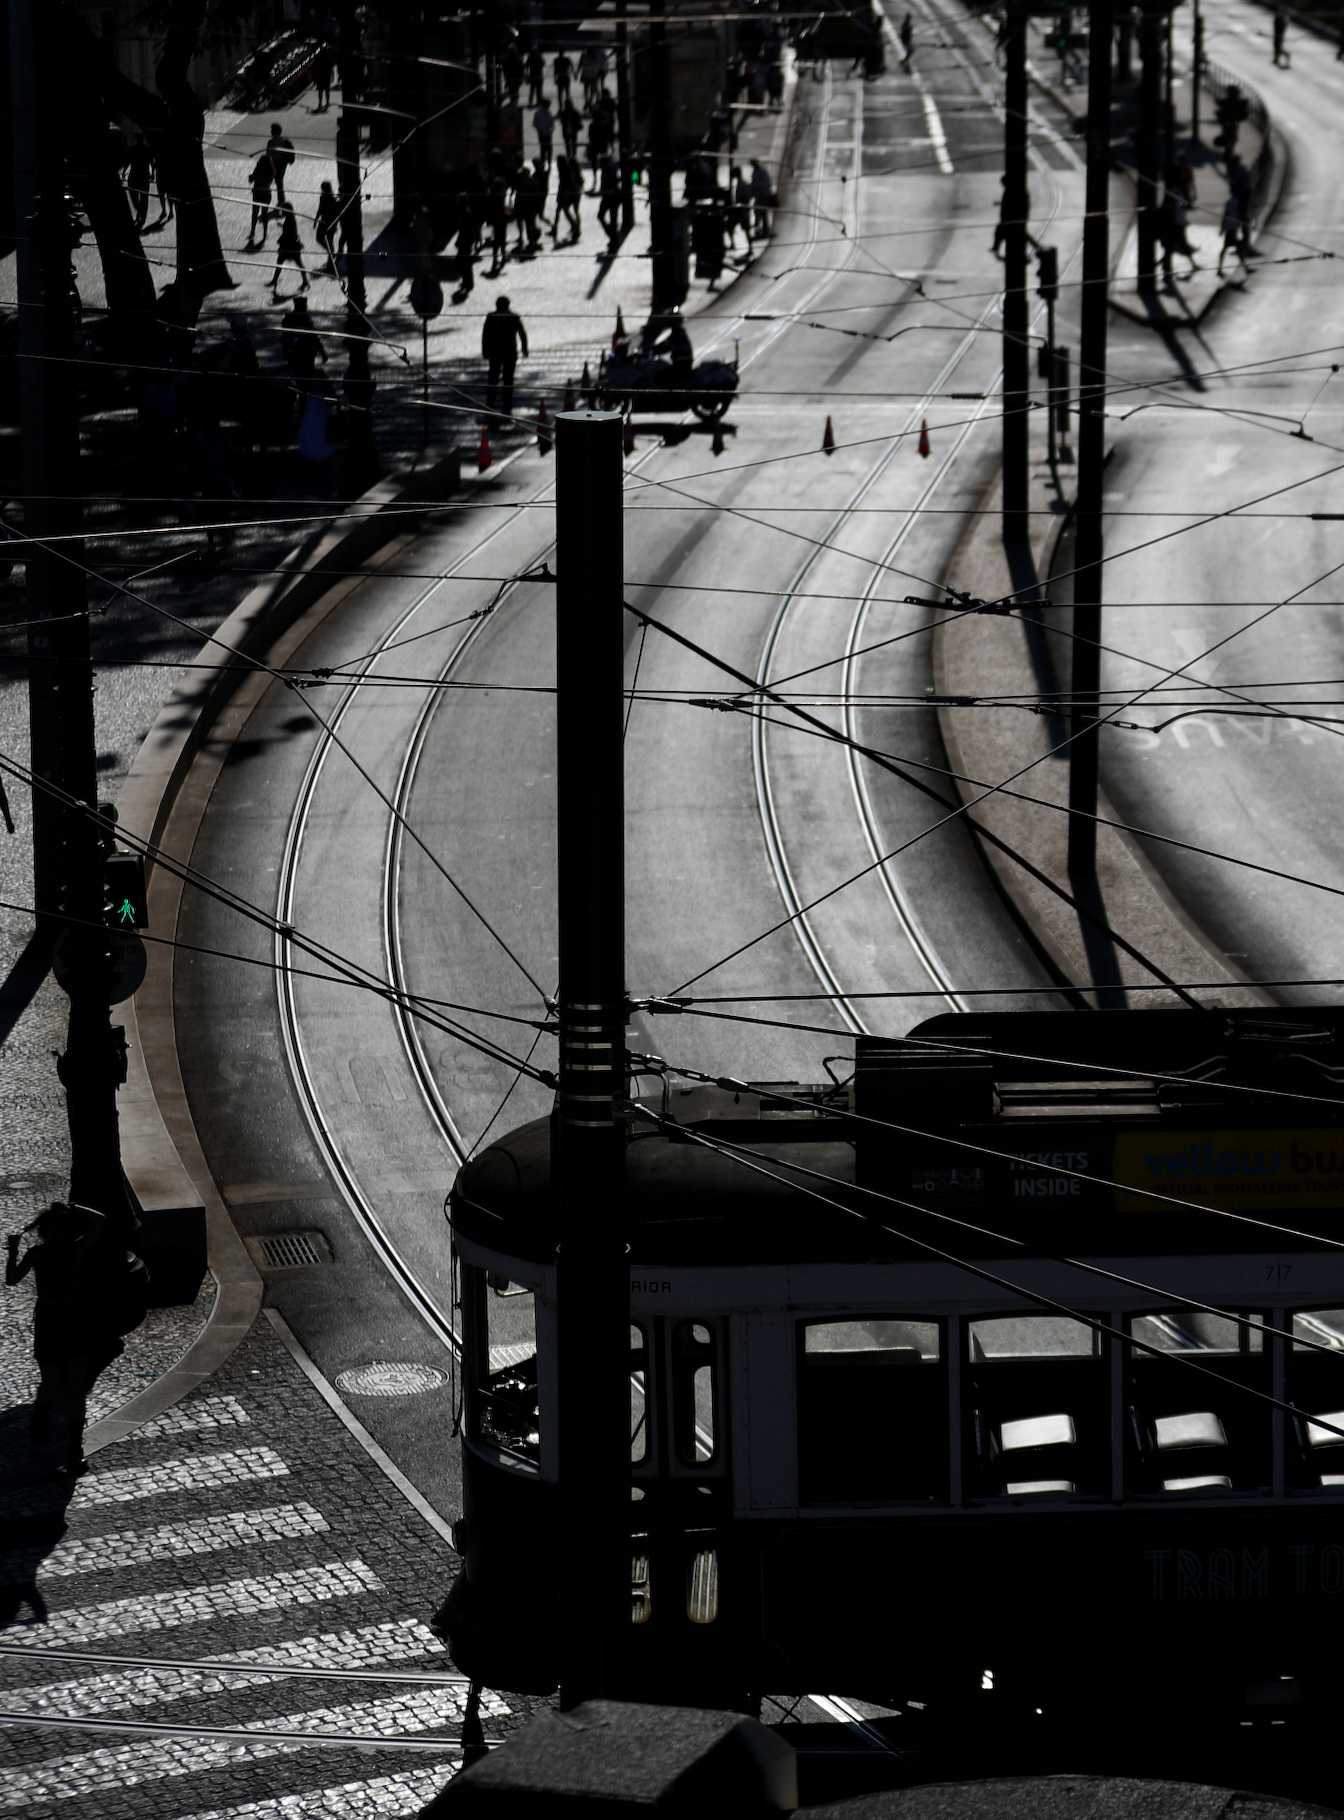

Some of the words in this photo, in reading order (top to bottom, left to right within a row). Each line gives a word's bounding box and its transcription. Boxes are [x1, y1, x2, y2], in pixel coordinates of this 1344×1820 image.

[1010, 1151, 1089, 1171] TICKETS
[1143, 1143, 1281, 1178] yellow
[1014, 1178, 1082, 1197] INSIDE
[1153, 1182, 1209, 1196] OFFICIAL
[1214, 1180, 1301, 1195] SIGHTSEEING
[1265, 1264, 1292, 1281] 717
[1144, 1546, 1270, 1600] TRAM
